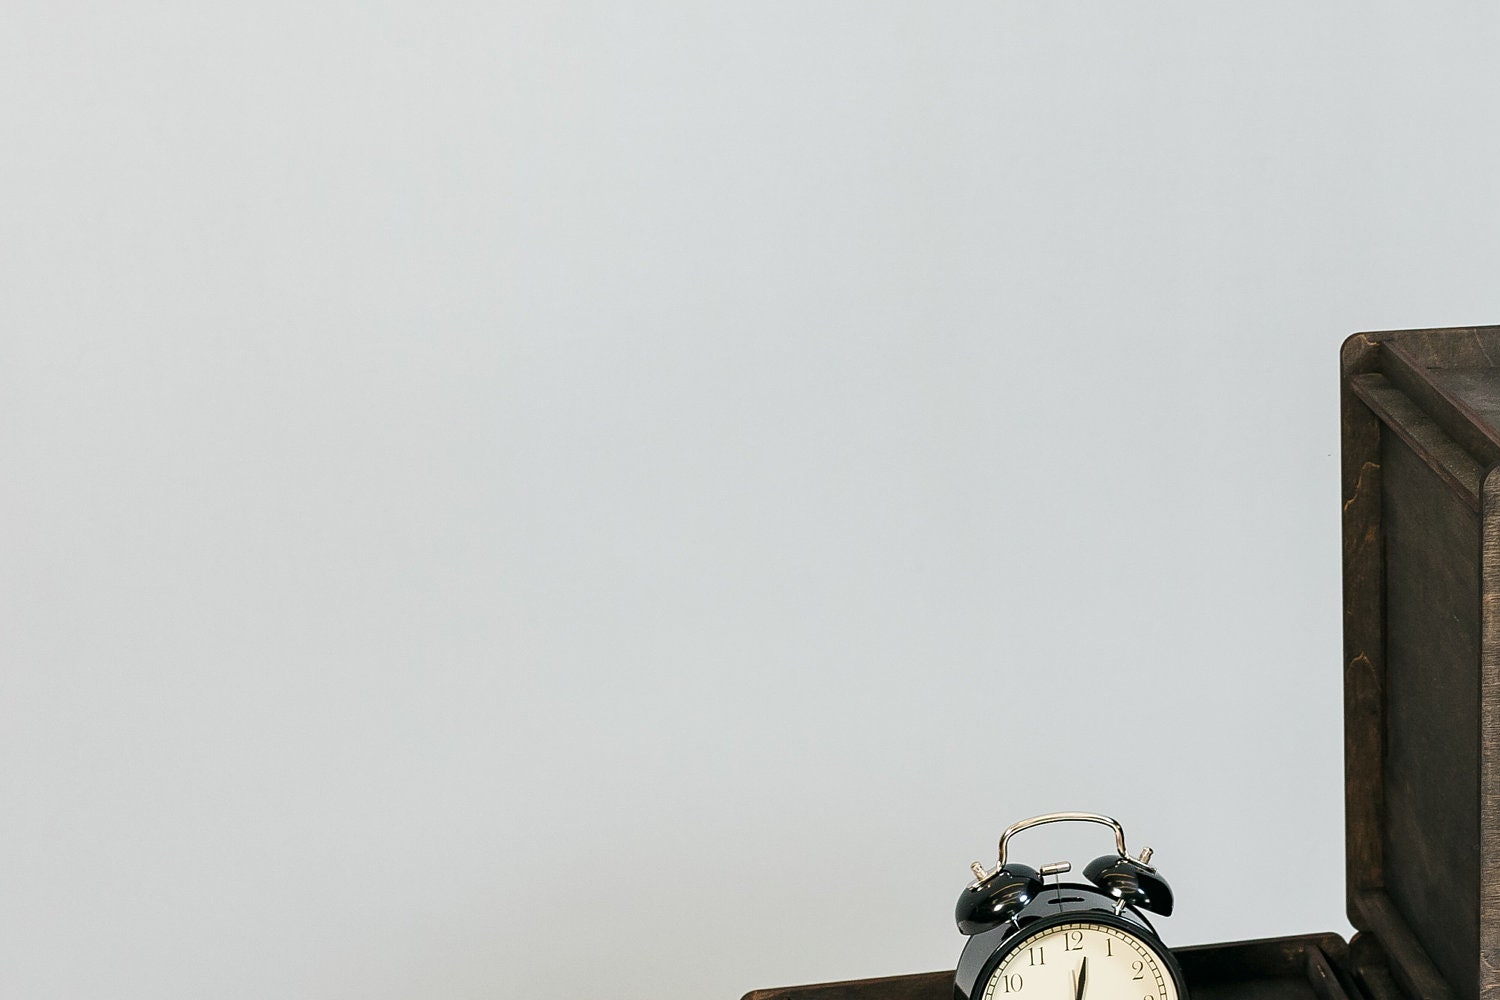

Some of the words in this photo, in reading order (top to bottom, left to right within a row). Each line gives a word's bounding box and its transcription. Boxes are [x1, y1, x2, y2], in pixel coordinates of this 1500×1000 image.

[1063, 931, 1083, 951] 12
[1106, 937, 1113, 957] 1
[1028, 947, 1045, 966] 11
[1132, 959, 1145, 980] 2
[1003, 973, 1023, 993] 10
